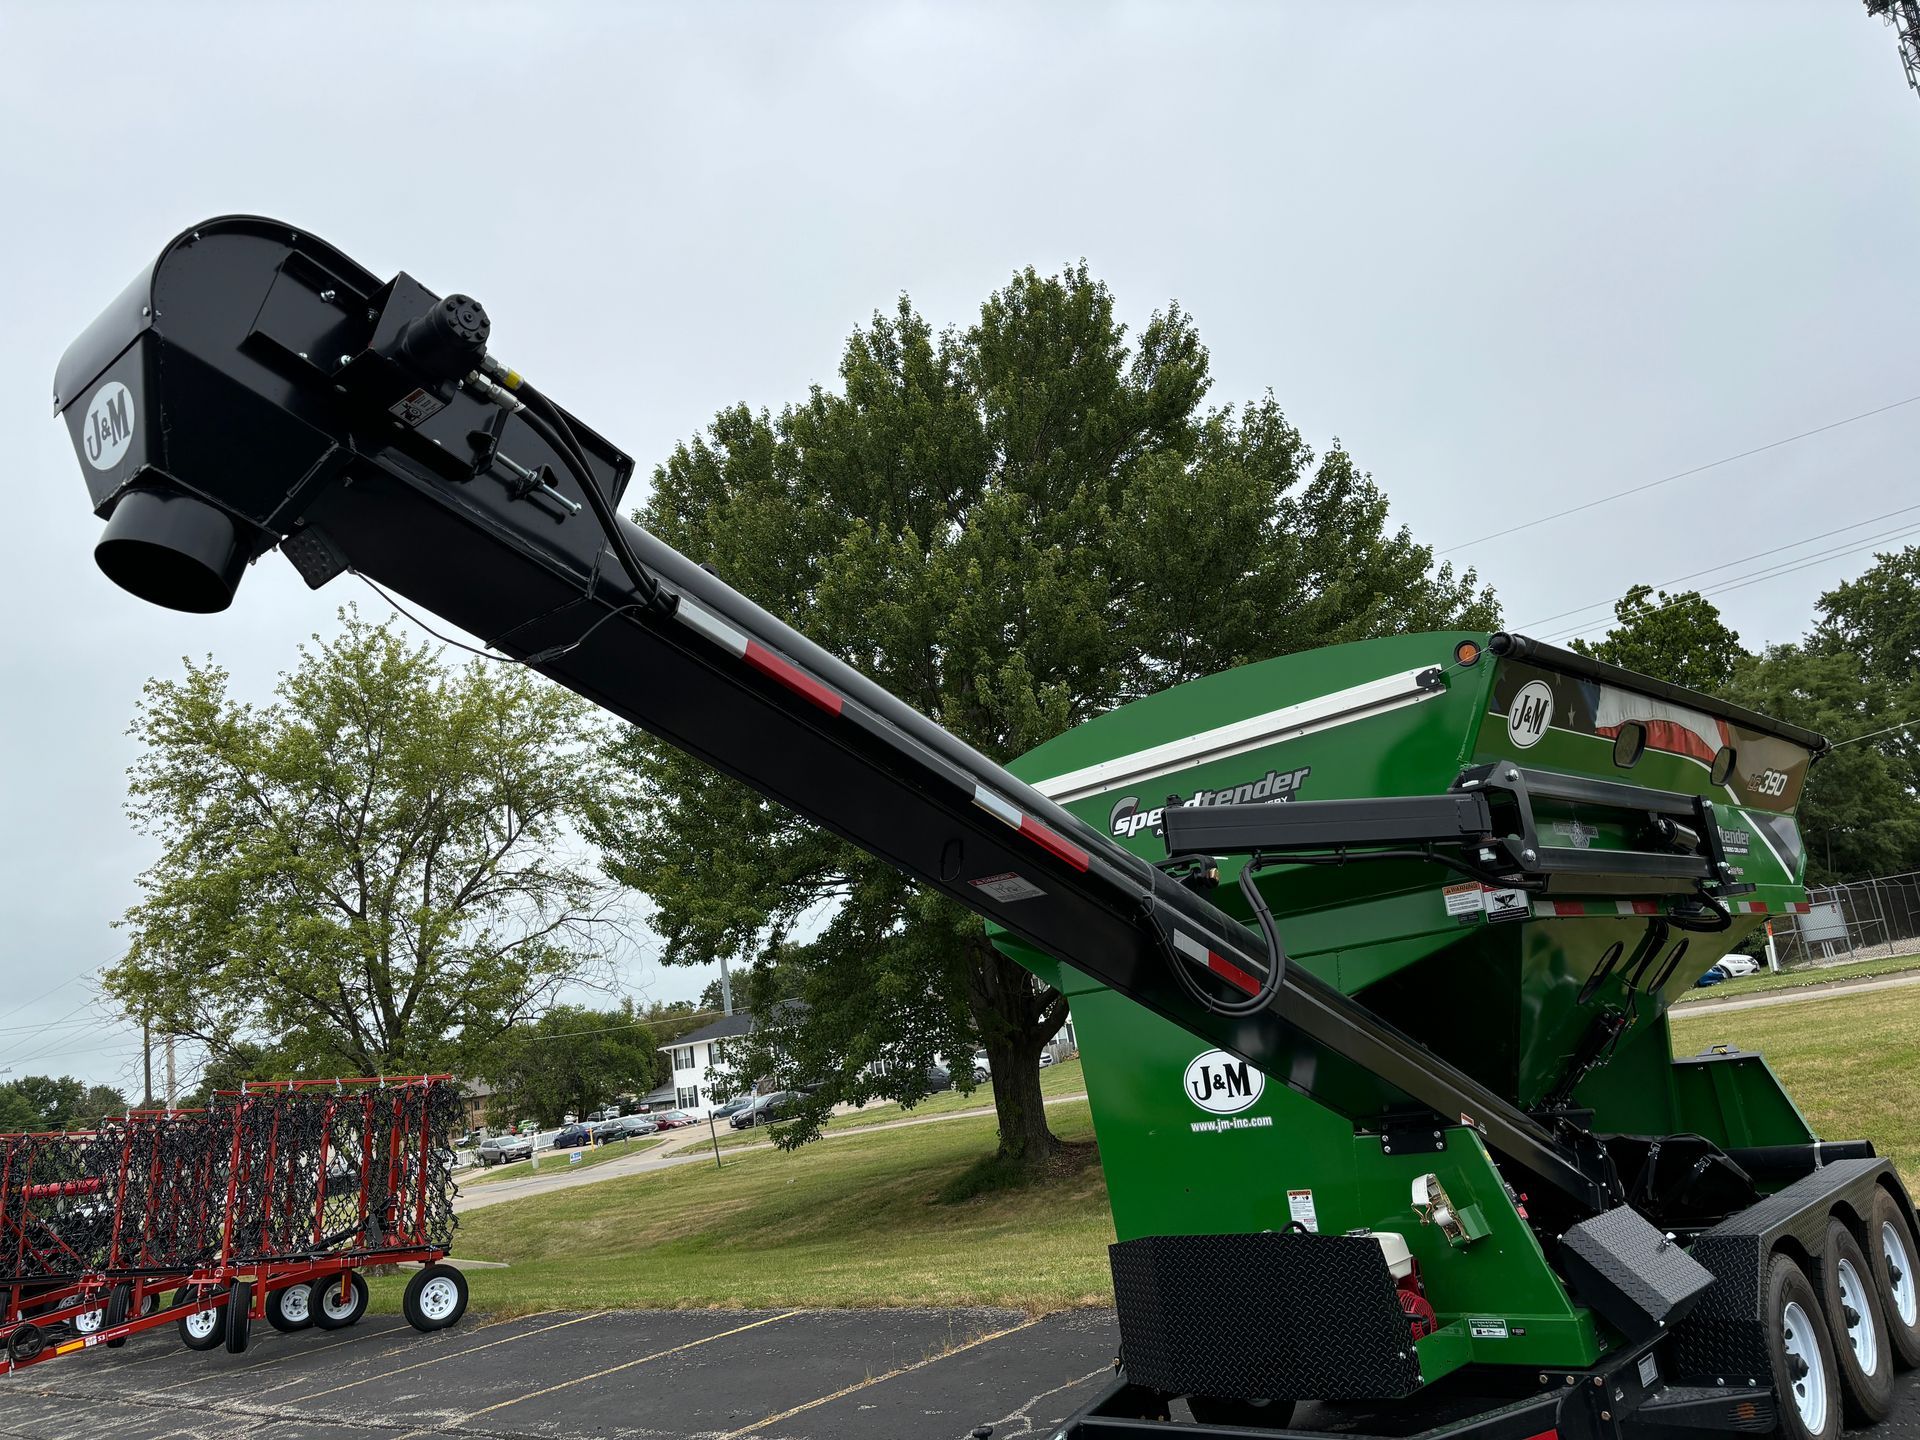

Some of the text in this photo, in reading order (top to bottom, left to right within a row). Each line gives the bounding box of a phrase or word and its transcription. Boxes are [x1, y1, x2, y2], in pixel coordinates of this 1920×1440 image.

[86, 388, 130, 461] J&M
[1511, 694, 1549, 735] J&M
[1112, 767, 1310, 838] spedtender
[1191, 1061, 1253, 1101] J&M
[1190, 1116, 1273, 1133] www.jm-inc.com
